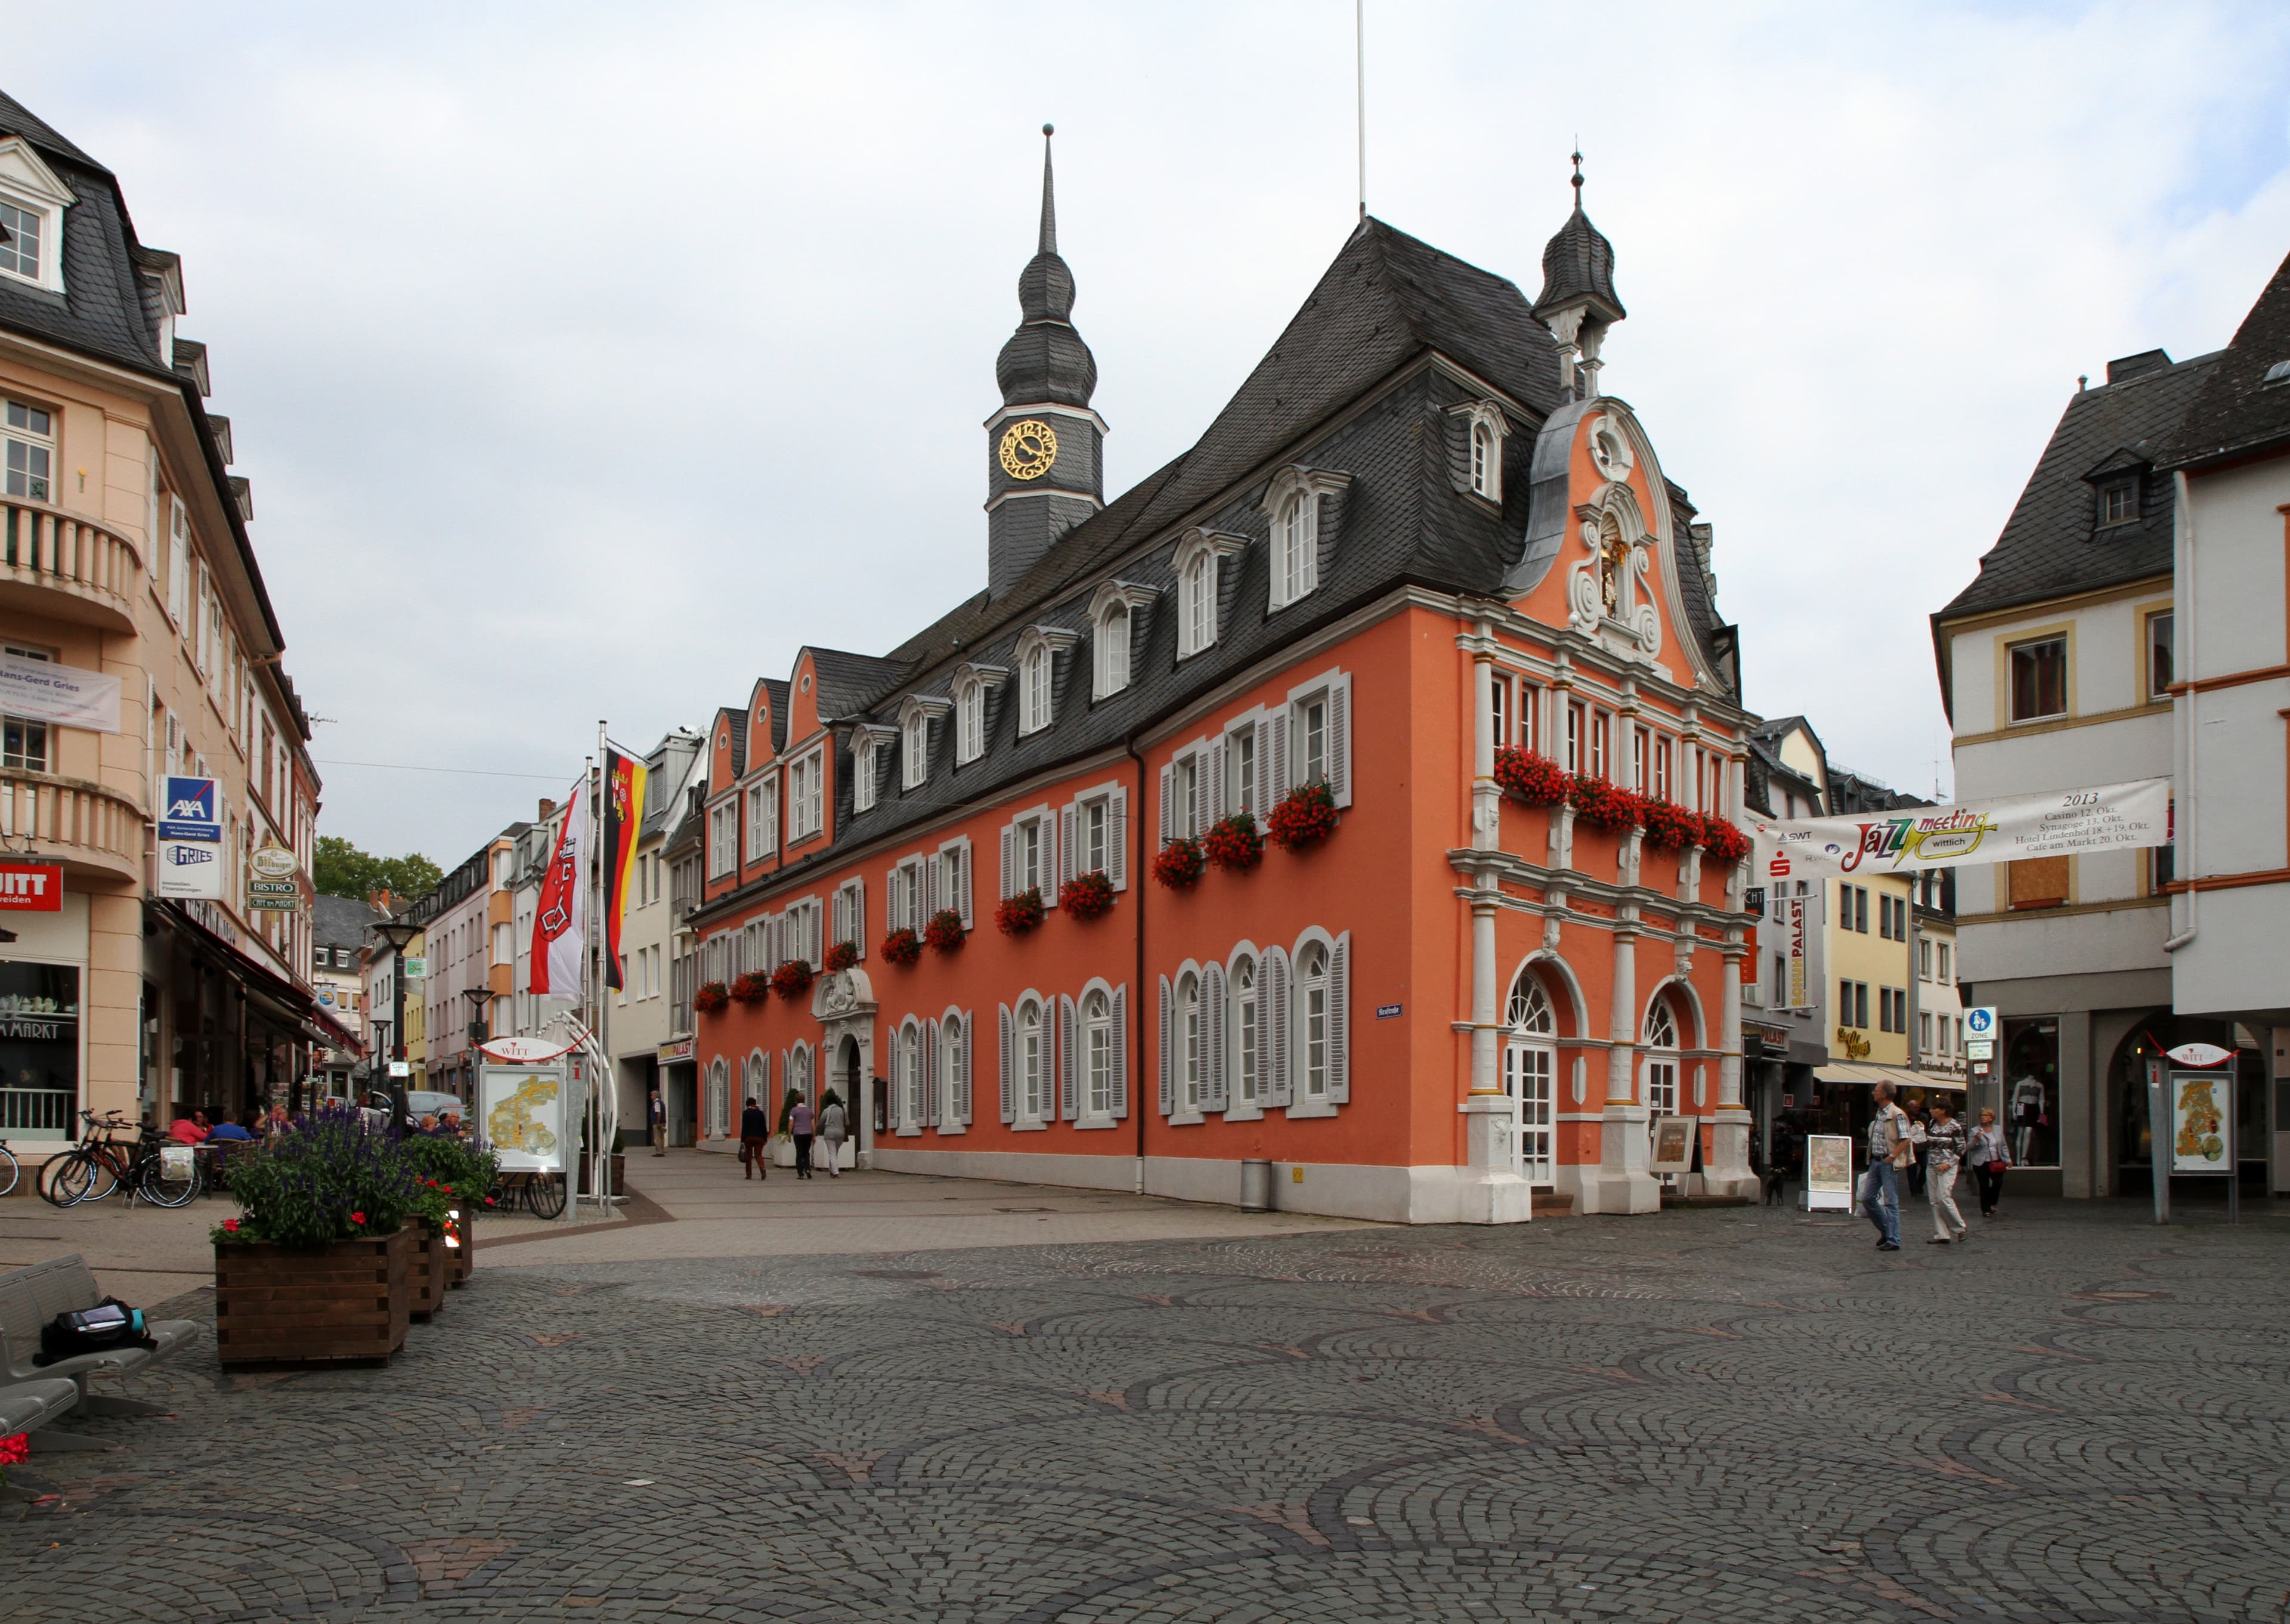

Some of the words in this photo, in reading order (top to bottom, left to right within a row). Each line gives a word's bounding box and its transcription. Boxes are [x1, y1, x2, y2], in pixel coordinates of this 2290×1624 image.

[1022, 423, 1035, 434] 12
[1035, 425, 1042, 437] 1
[1005, 437, 1015, 447] 10
[1043, 431, 1053, 442] 2
[1002, 447, 1013, 458] 9
[1044, 442, 1054, 454] 3
[1005, 456, 1015, 468] 8
[1033, 457, 1044, 473] 5
[1042, 453, 1052, 467] 4
[1011, 465, 1023, 476] 7
[1022, 466, 1034, 478] 6
[54, 680, 79, 692] Gries
[2062, 792, 2099, 807] 2013
[168, 800, 206, 818] AXA
[2045, 812, 2077, 821] Casino
[2081, 809, 2093, 817] 12.
[2097, 806, 2118, 815] Okt.
[2040, 821, 2084, 832] Synagoge
[2087, 818, 2100, 827] 13.
[2103, 814, 2124, 823] Okt.
[1790, 831, 1812, 840] SWT
[2015, 834, 2040, 845] Hotel
[2043, 827, 2091, 841] Lindenhof
[2129, 822, 2150, 831] Okt.
[1932, 838, 1966, 848] wittlich
[2067, 838, 2096, 847] Markt
[2099, 836, 2113, 845] 20.
[2116, 834, 2137, 842] Okt.
[177, 845, 213, 865] GRIES
[0, 873, 47, 895] ITT
[254, 883, 293, 892] BISTRO
[10, 1022, 58, 1039] MARKT
[502, 1047, 530, 1056] WITT
